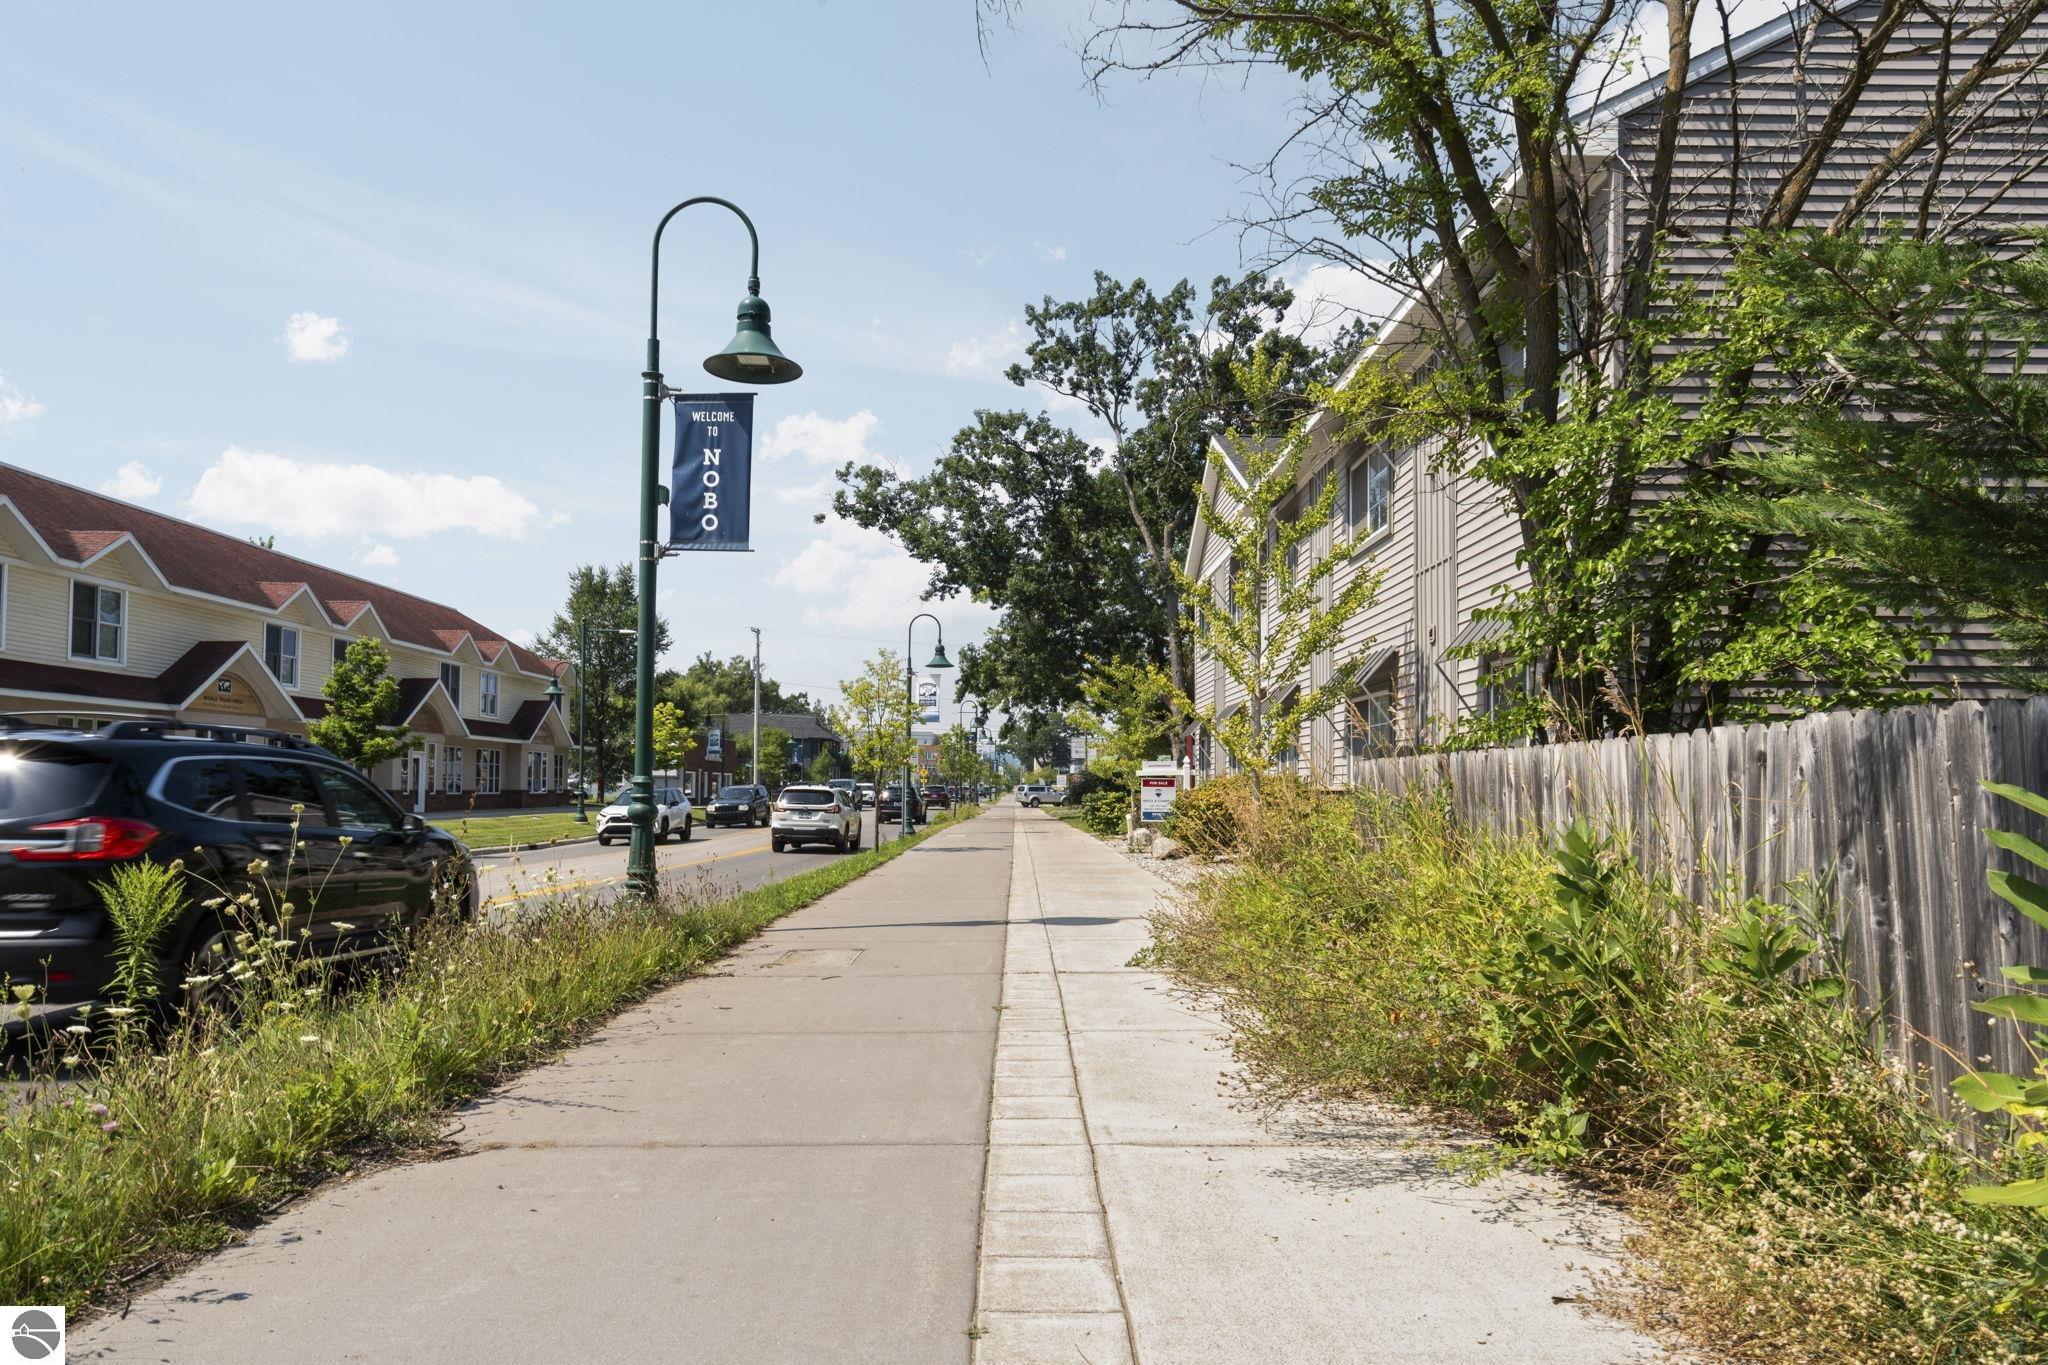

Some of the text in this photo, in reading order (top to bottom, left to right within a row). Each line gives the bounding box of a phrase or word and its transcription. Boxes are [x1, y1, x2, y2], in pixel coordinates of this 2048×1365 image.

[692, 411, 735, 422] WELCOME
[707, 426, 718, 437] TO
[701, 448, 721, 531] NOBO
